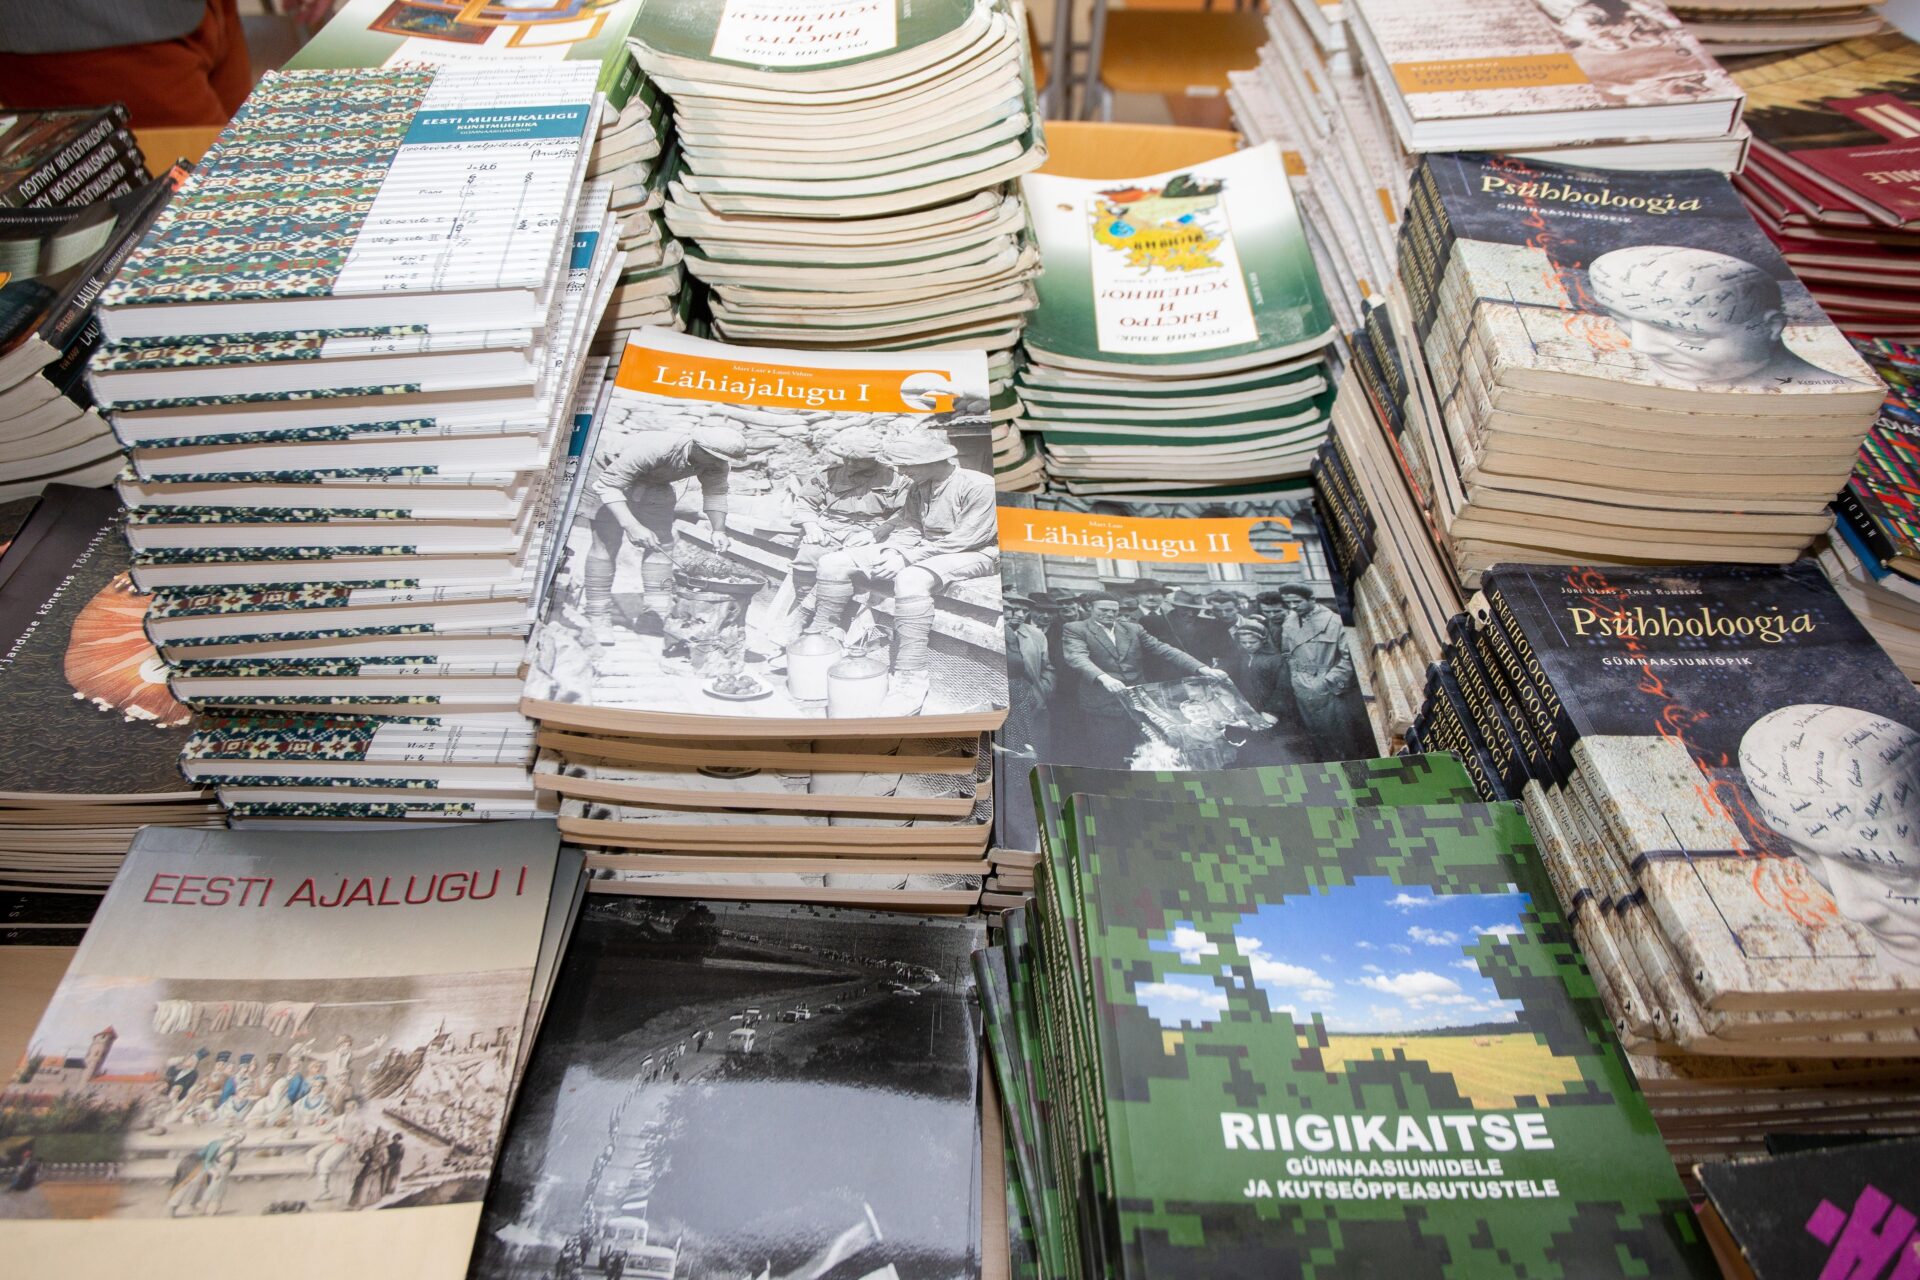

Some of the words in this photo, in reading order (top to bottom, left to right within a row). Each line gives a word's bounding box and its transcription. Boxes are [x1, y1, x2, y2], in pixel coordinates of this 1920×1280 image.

[422, 117, 462, 126] EESTI
[466, 112, 578, 124] MUUSIKALUGU
[457, 122, 538, 131] KUNSTMUUSIKA
[55, 117, 114, 172] KUNSTIKULTUURI
[19, 161, 57, 200] AJALUGU
[50, 144, 117, 202] KUNSTIKULTUURI
[1480, 175, 1703, 215] Psühholoogia
[73, 276, 105, 309] LAULIK
[1101, 278, 1230, 299] УСПЕШНО!
[1159, 302, 1175, 312] И
[1119, 310, 1219, 327] БЫСТРО
[652, 365, 847, 406] Lähiajalugu
[857, 383, 871, 402] I
[1023, 522, 1199, 558] Lähiajalugu
[1206, 533, 1233, 553] II
[36, 574, 75, 616] kõnetus
[1566, 605, 1816, 643] Psühholoogia
[1602, 655, 1753, 667] GÜMNAASIUMIÕPIK
[1436, 686, 1496, 801] PSÜHHOLOOGI
[144, 872, 275, 907] EESTI
[284, 868, 502, 908] AJALUGU
[516, 864, 529, 896] I
[1220, 1112, 1555, 1153] RIIGIKAITSE
[1286, 1157, 1504, 1178] GÜMNAASIUMIDELE
[1243, 1180, 1273, 1199] JA
[1277, 1178, 1560, 1200] KUTSEÕPPEASUTUSTELE
